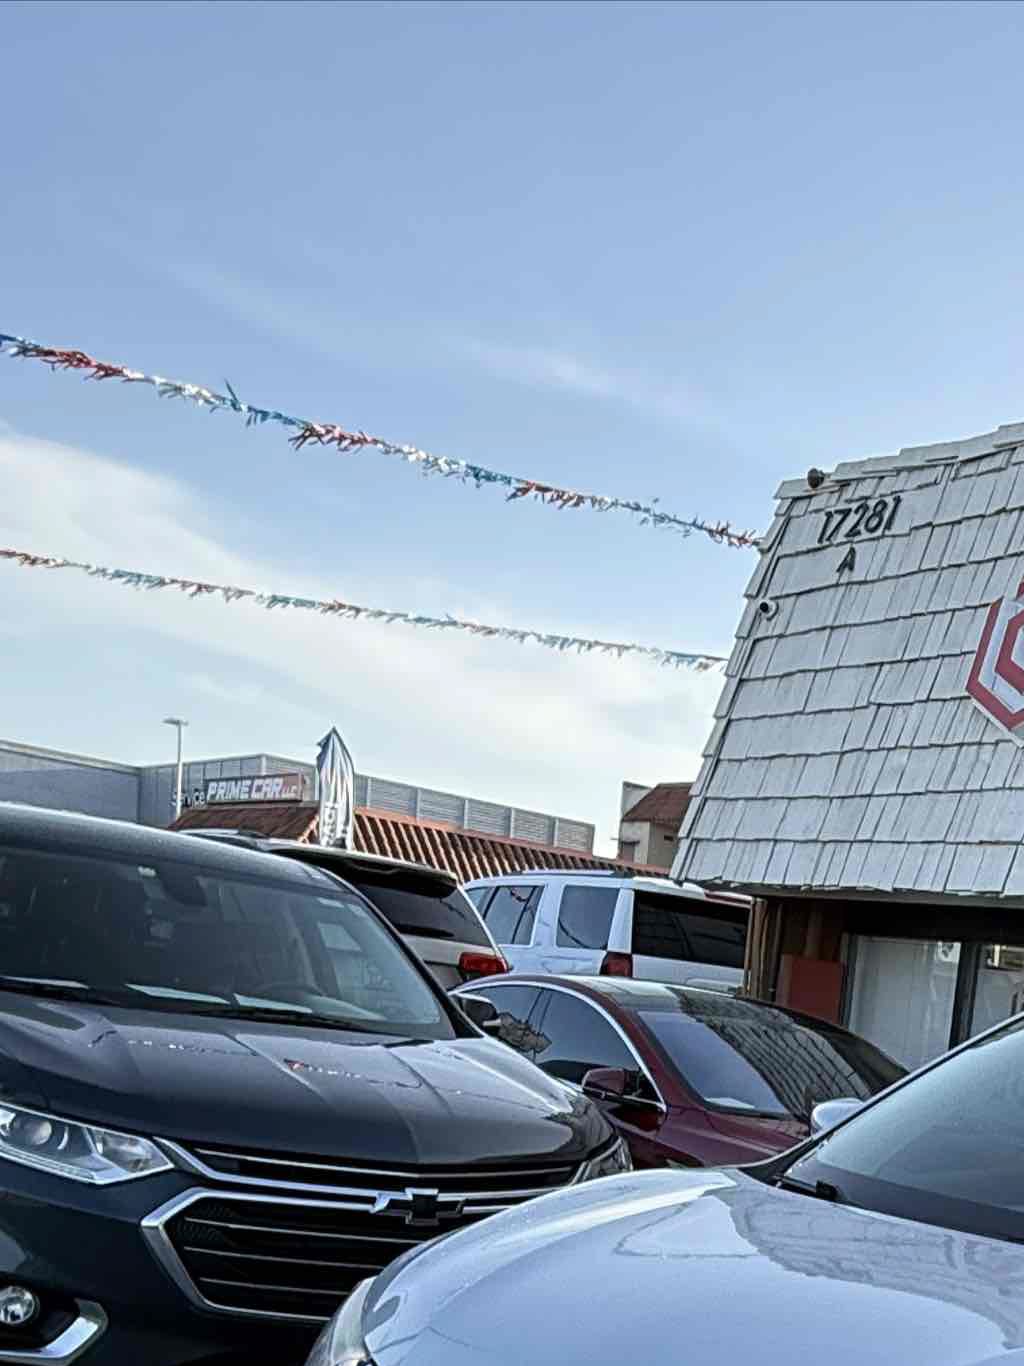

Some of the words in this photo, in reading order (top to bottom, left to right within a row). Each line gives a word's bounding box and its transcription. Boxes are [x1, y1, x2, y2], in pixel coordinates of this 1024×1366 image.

[817, 496, 902, 544] 17281
[836, 546, 856, 572] A
[207, 779, 251, 801] PRIME
[251, 777, 284, 799] CAR
